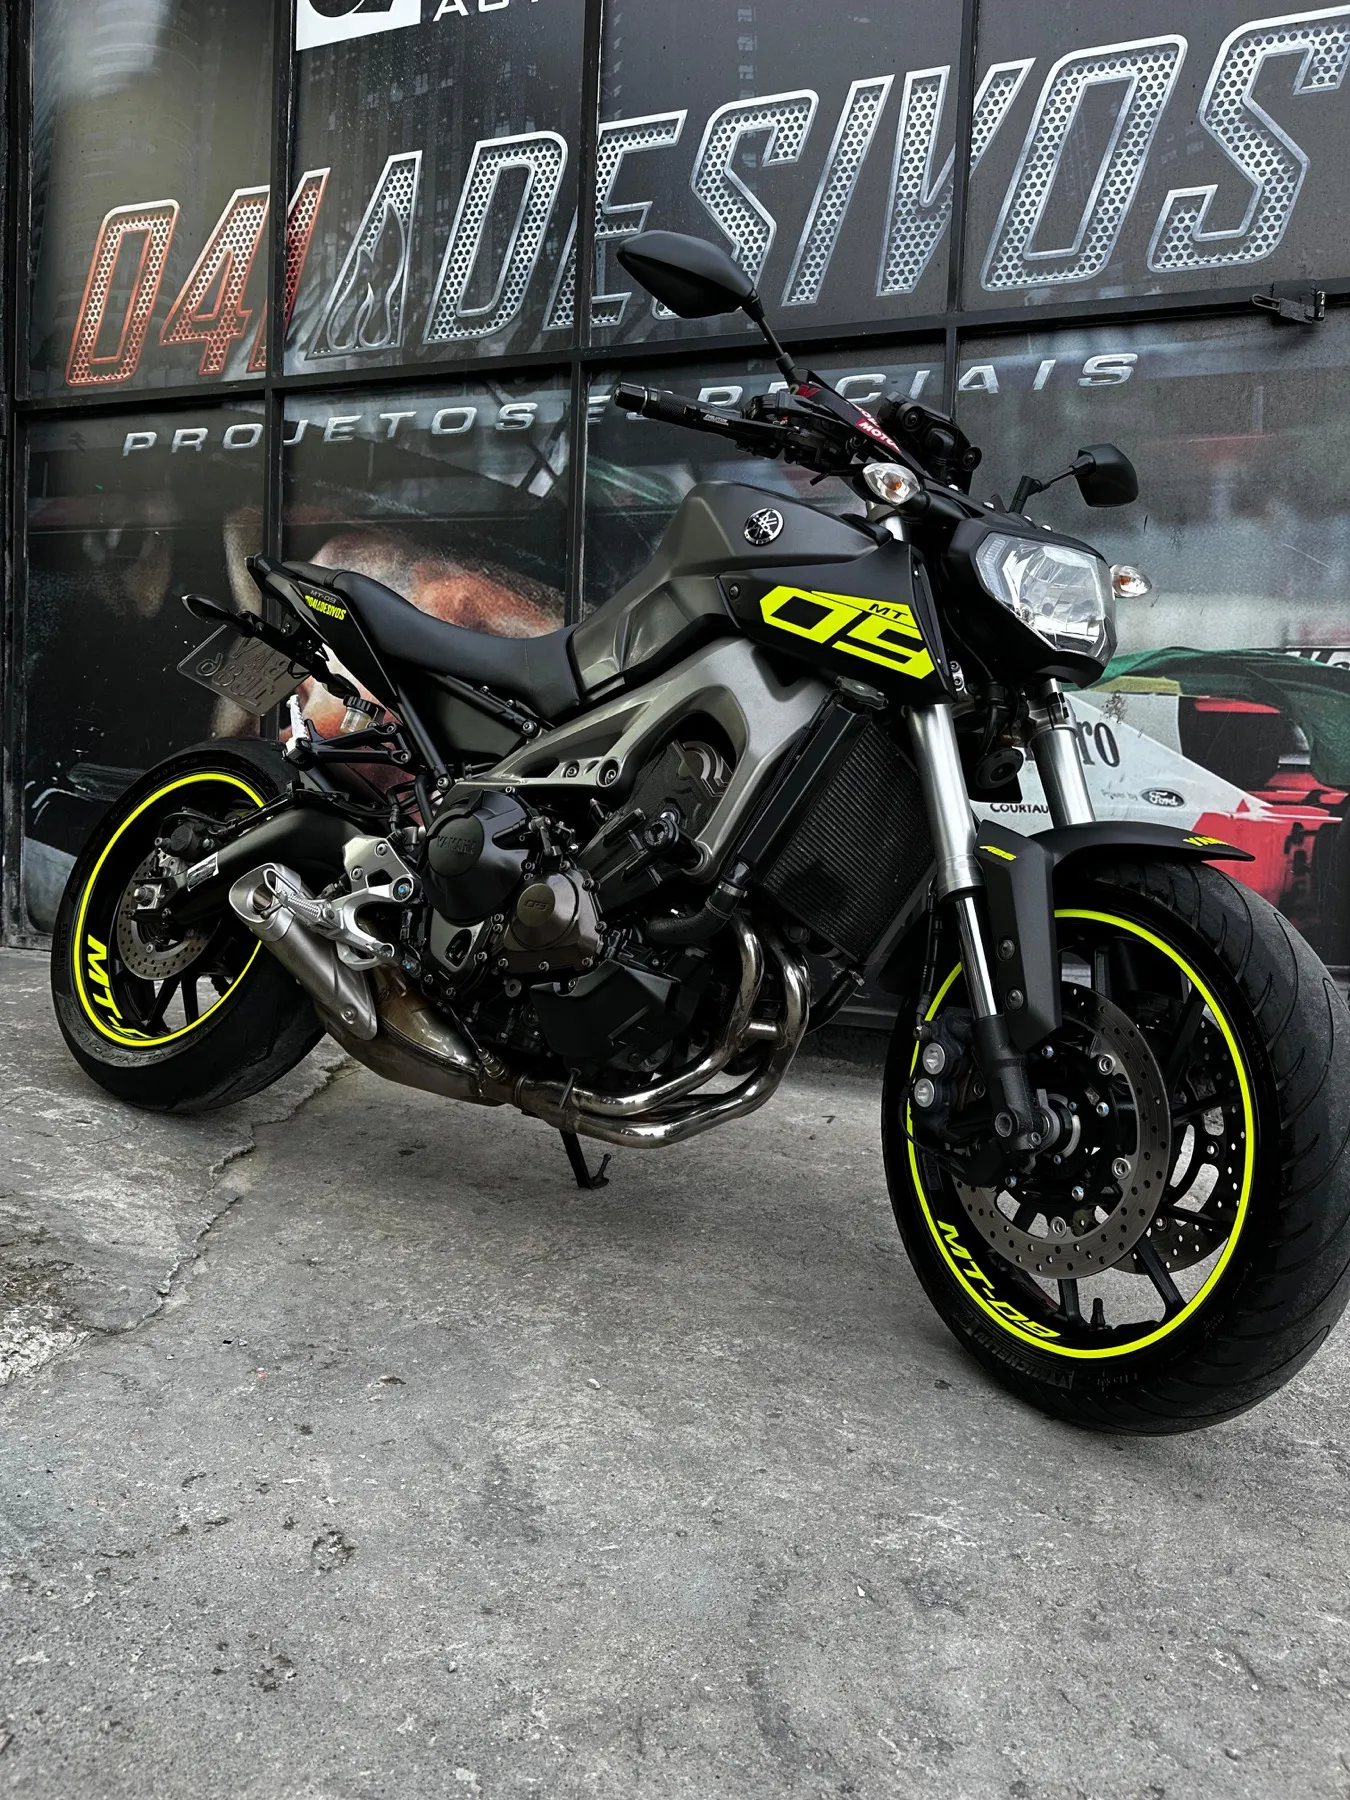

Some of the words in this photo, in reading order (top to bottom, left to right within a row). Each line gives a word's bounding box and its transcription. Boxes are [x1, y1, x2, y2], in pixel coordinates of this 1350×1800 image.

[123, 402, 538, 456] PROJETOS
[869, 603, 908, 619] MT
[759, 585, 936, 680] 09
[989, 803, 1050, 814] COURTAU
[1149, 791, 1178, 806] Ford
[936, 1220, 1062, 1339] MT-09
